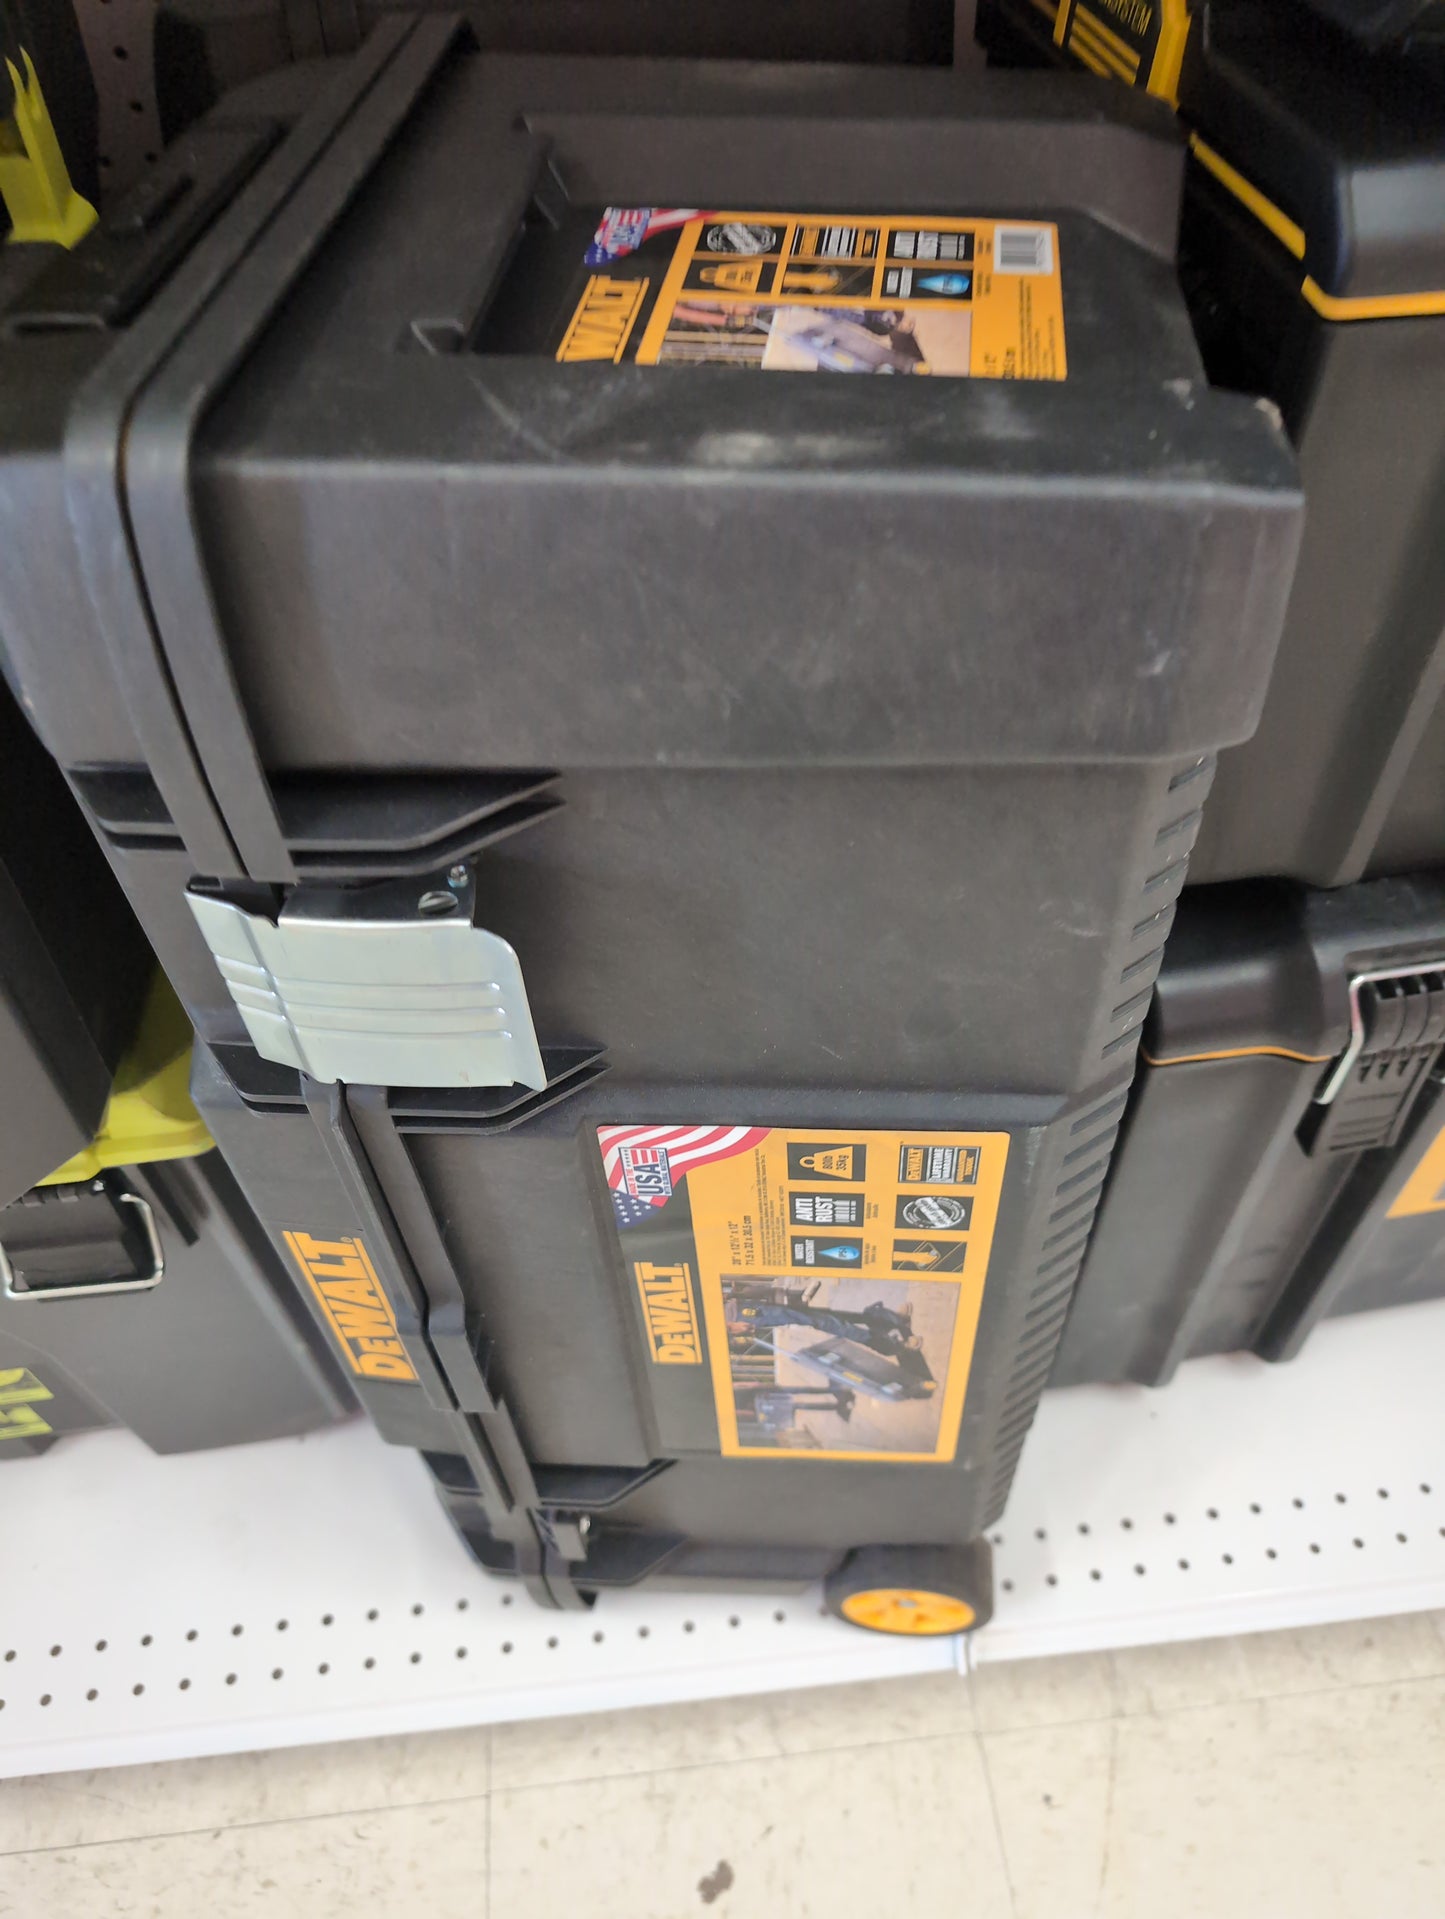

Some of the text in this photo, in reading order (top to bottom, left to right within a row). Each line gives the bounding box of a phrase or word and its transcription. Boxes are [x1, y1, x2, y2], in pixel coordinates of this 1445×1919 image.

[558, 275, 647, 362] WALT
[634, 1164, 664, 1194] USA
[795, 1197, 813, 1221] ANTI
[815, 1196, 833, 1223] RUST
[284, 1231, 419, 1381] DEWALT
[635, 1262, 701, 1364] DEWALT
